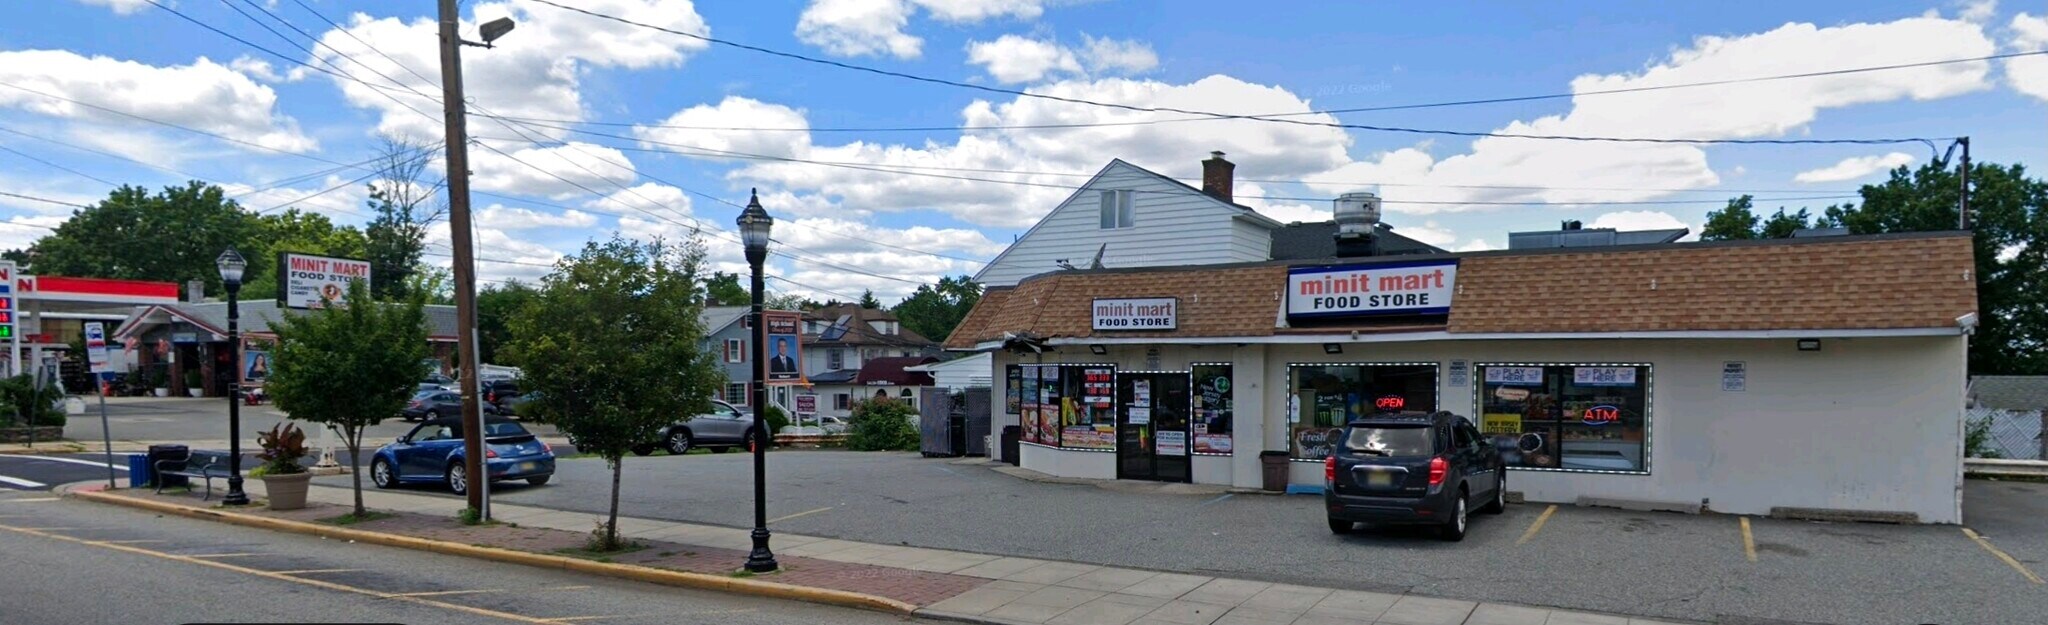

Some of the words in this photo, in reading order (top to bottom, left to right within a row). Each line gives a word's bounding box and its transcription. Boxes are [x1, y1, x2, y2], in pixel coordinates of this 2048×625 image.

[291, 257, 328, 273] MINIT
[333, 261, 367, 276] MART
[291, 271, 325, 281] FOOD
[1300, 273, 1370, 295] minit
[1379, 269, 1444, 291] mart
[1314, 296, 1360, 309] FOOD
[1369, 293, 1429, 307] STORE
[1096, 302, 1133, 317] minit
[1137, 302, 1172, 317] mart
[1099, 318, 1128, 326] FOOD
[1132, 318, 1170, 326] STORE
[1376, 398, 1404, 408] OPEN
[1584, 408, 1617, 420] ATM
[1300, 432, 1326, 442] Fresh
